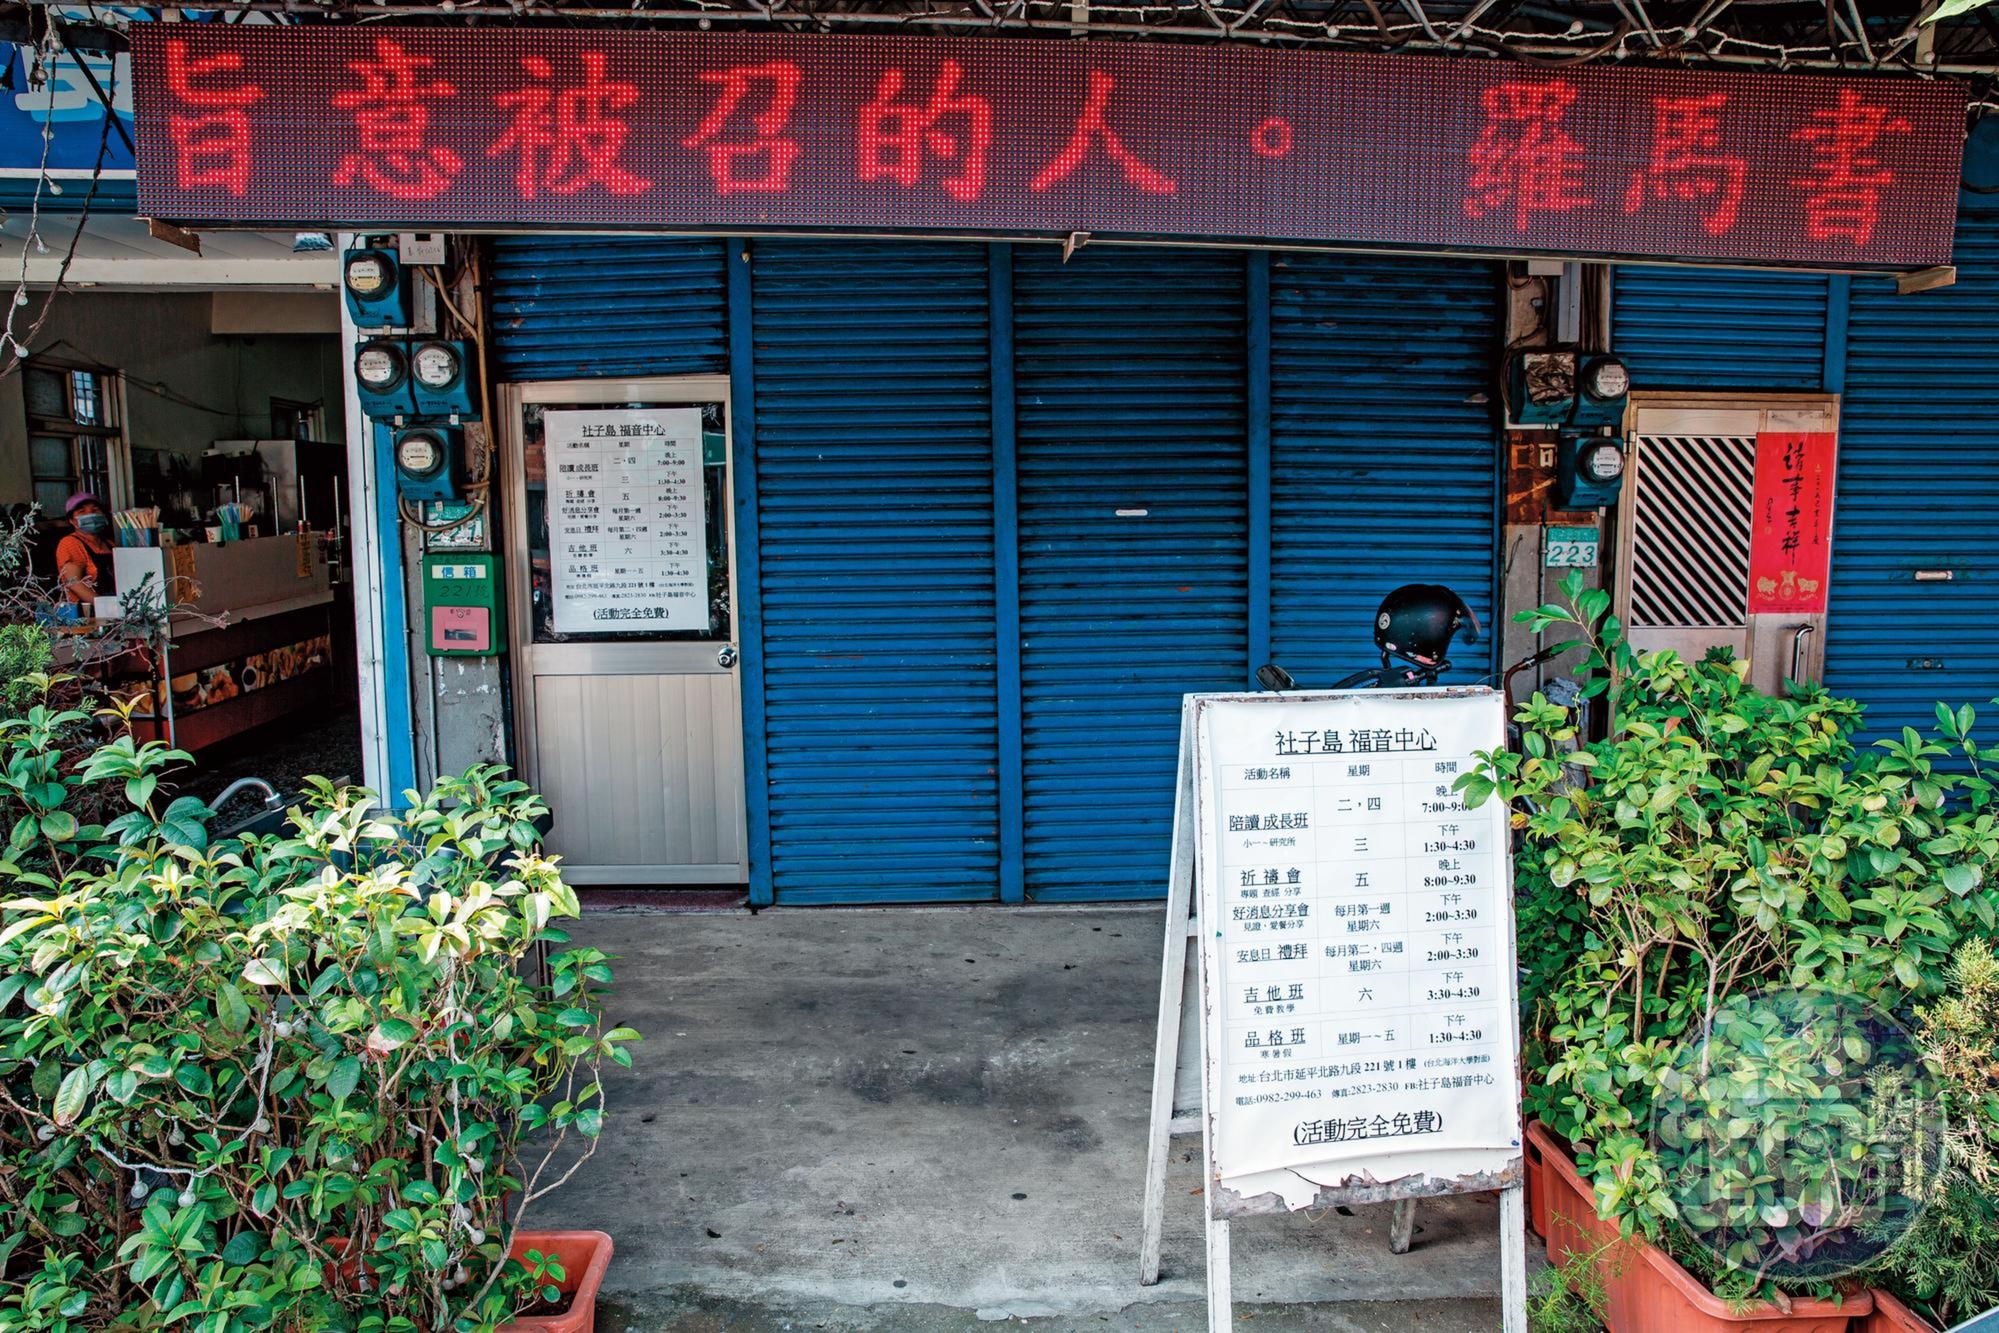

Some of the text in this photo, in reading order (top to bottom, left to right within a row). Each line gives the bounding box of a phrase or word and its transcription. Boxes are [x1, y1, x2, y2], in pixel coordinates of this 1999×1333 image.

[1463, 78, 1913, 246] 羅馬書
[582, 424, 666, 437] 社子島 福音中心
[1549, 544, 1596, 563] 223
[442, 566, 476, 579] 信箱
[593, 607, 669, 620] (活動完全免費)
[1275, 727, 1437, 755] 社子島 福音中心
[1244, 767, 1291, 780] 活動名稱
[1347, 764, 1370, 777] 星期
[1435, 761, 1457, 774] 時間
[1422, 802, 1472, 813] 7:00~9:0
[1229, 812, 1309, 831] 陪讀 成長班
[1438, 824, 1459, 836] 下午
[1354, 837, 1368, 852] 三
[1424, 840, 1475, 852] 1:30~4:30
[1438, 859, 1461, 871] 晚上
[1355, 872, 1369, 887] 五
[1424, 874, 1476, 887] 8:00~9:30
[1440, 894, 1462, 906] 下午
[1233, 903, 1309, 920] 好消息分享會
[1335, 902, 1391, 917] 每月第一週
[1425, 909, 1477, 922] 2:00~3:30
[1346, 919, 1380, 933] 星期六
[1441, 933, 1463, 945] 下午
[1237, 943, 1308, 963] 安息日 禮拜
[1427, 948, 1479, 961] 2:00~3:30
[1348, 959, 1382, 973] 星期六
[1442, 971, 1464, 984] 下午
[1358, 987, 1373, 1002] 六
[1427, 987, 1480, 1000] 3:30~4:30
[1443, 1014, 1466, 1027] 下午
[1429, 1029, 1482, 1043] 1:30~4:30
[1293, 1110, 1443, 1147] (活動完全免費)
